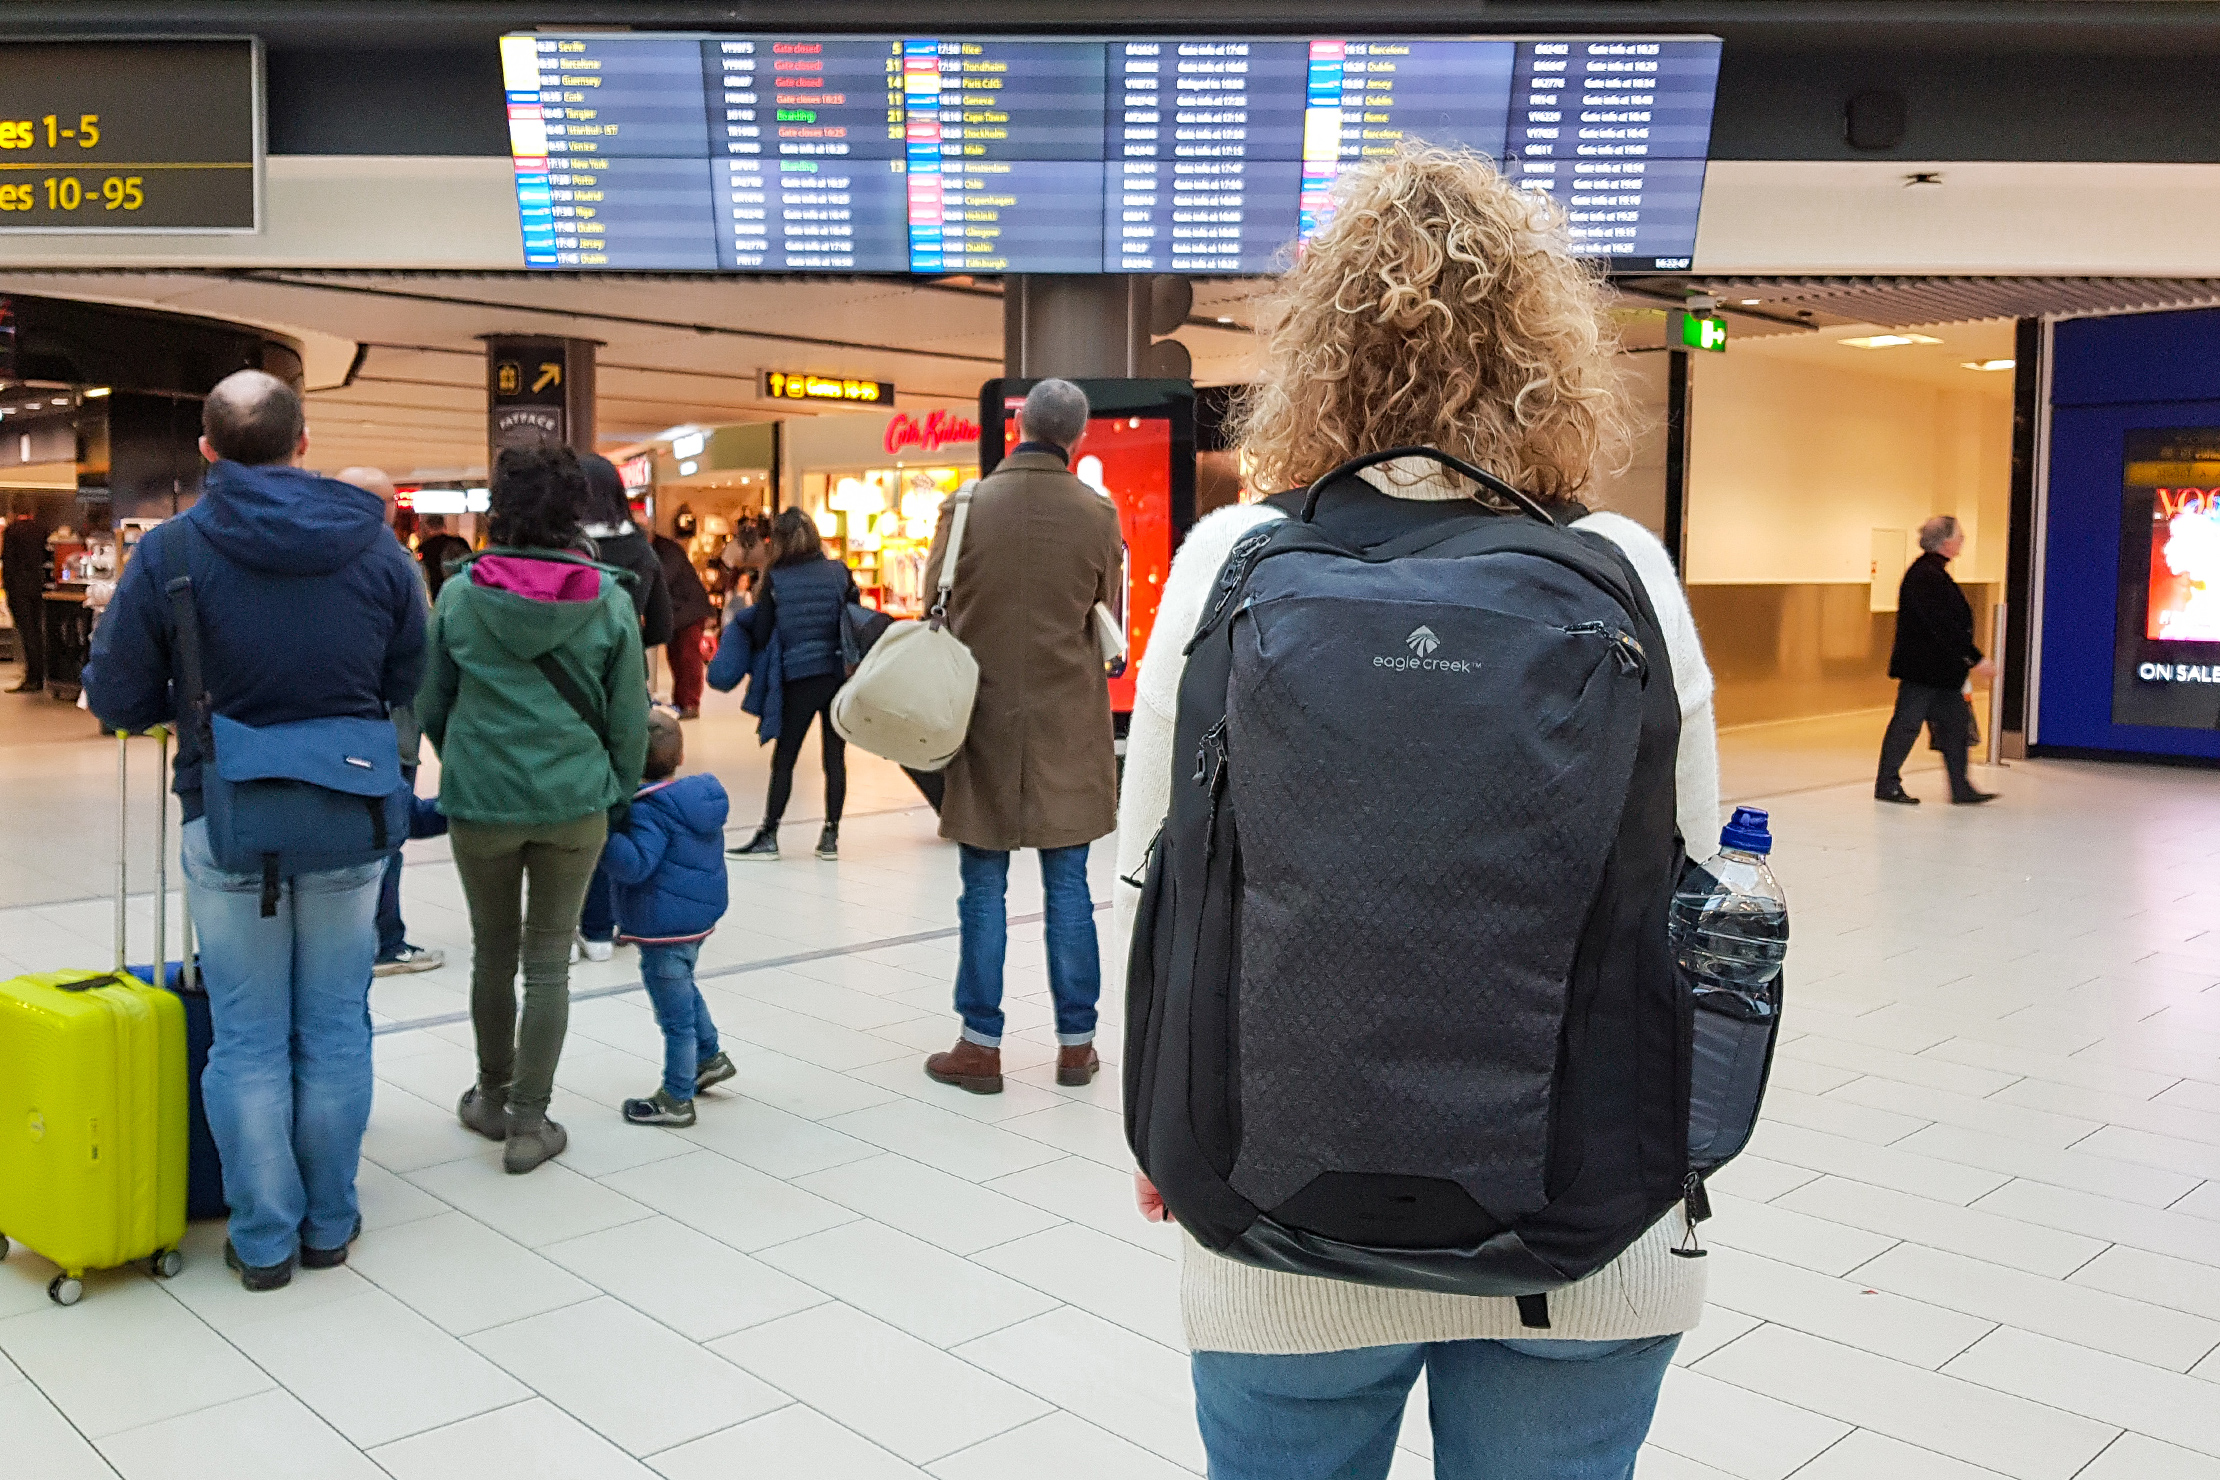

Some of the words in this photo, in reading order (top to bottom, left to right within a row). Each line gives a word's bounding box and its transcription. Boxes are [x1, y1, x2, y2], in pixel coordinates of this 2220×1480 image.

[558, 41, 586, 52] Seville
[774, 43, 793, 53] Gate
[961, 44, 983, 55] Nice
[1368, 45, 1409, 55] Barcelona
[774, 60, 794, 71] Gate
[1367, 61, 1396, 72] Dublin
[562, 76, 601, 87] Guernsey
[775, 76, 795, 87] Gate
[43, 115, 100, 149] 1-5
[44, 176, 144, 211] 10-95
[1373, 656, 1420, 671] eagle
[1423, 658, 1470, 673] creek
[2139, 663, 2174, 681] ON
[2176, 664, 2220, 683] SALE
